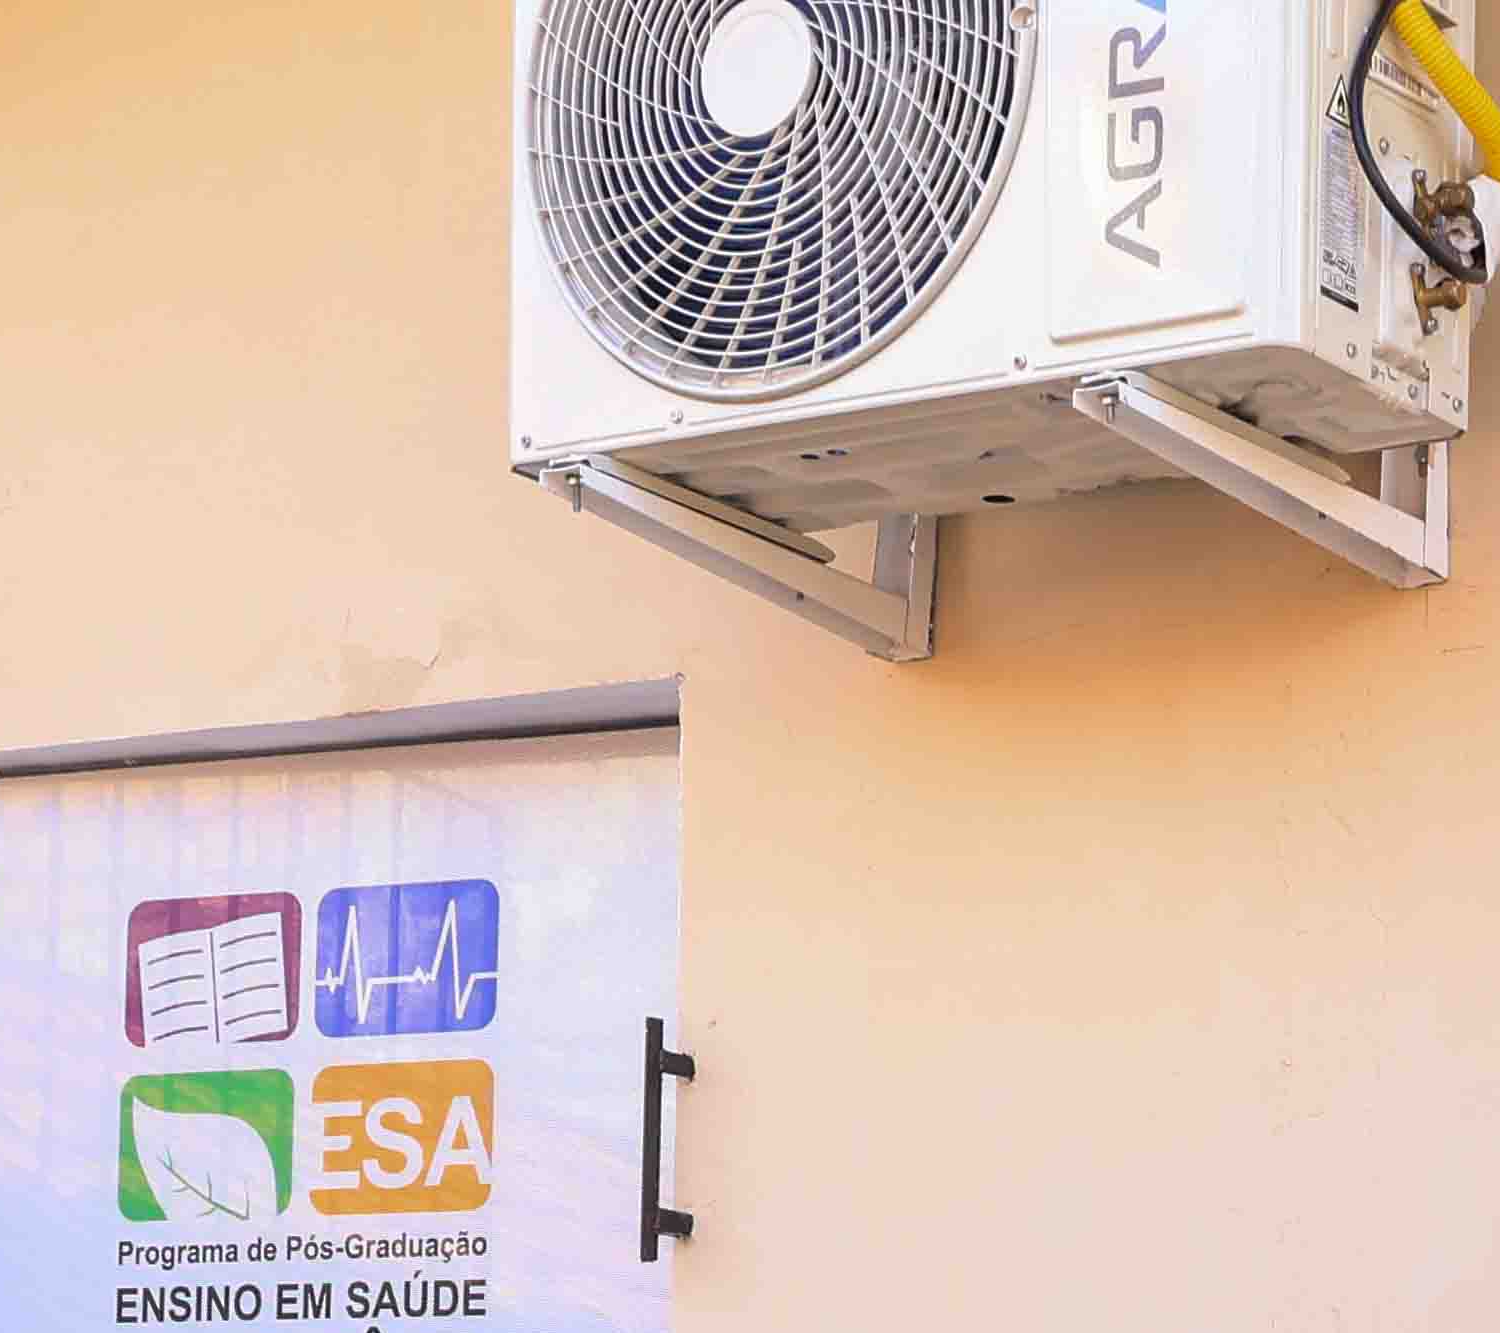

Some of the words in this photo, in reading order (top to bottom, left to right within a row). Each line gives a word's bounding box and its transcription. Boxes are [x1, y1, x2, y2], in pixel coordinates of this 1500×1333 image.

[1104, 0, 1167, 268] AGR
[310, 1095, 491, 1188] ESA
[118, 1240, 238, 1270] Programa
[247, 1237, 277, 1262] de
[286, 1231, 488, 1263] Pós-Graduação
[115, 1283, 262, 1323] ENSINO
[275, 1283, 332, 1320] EM
[346, 1270, 487, 1319] SAÚDE
